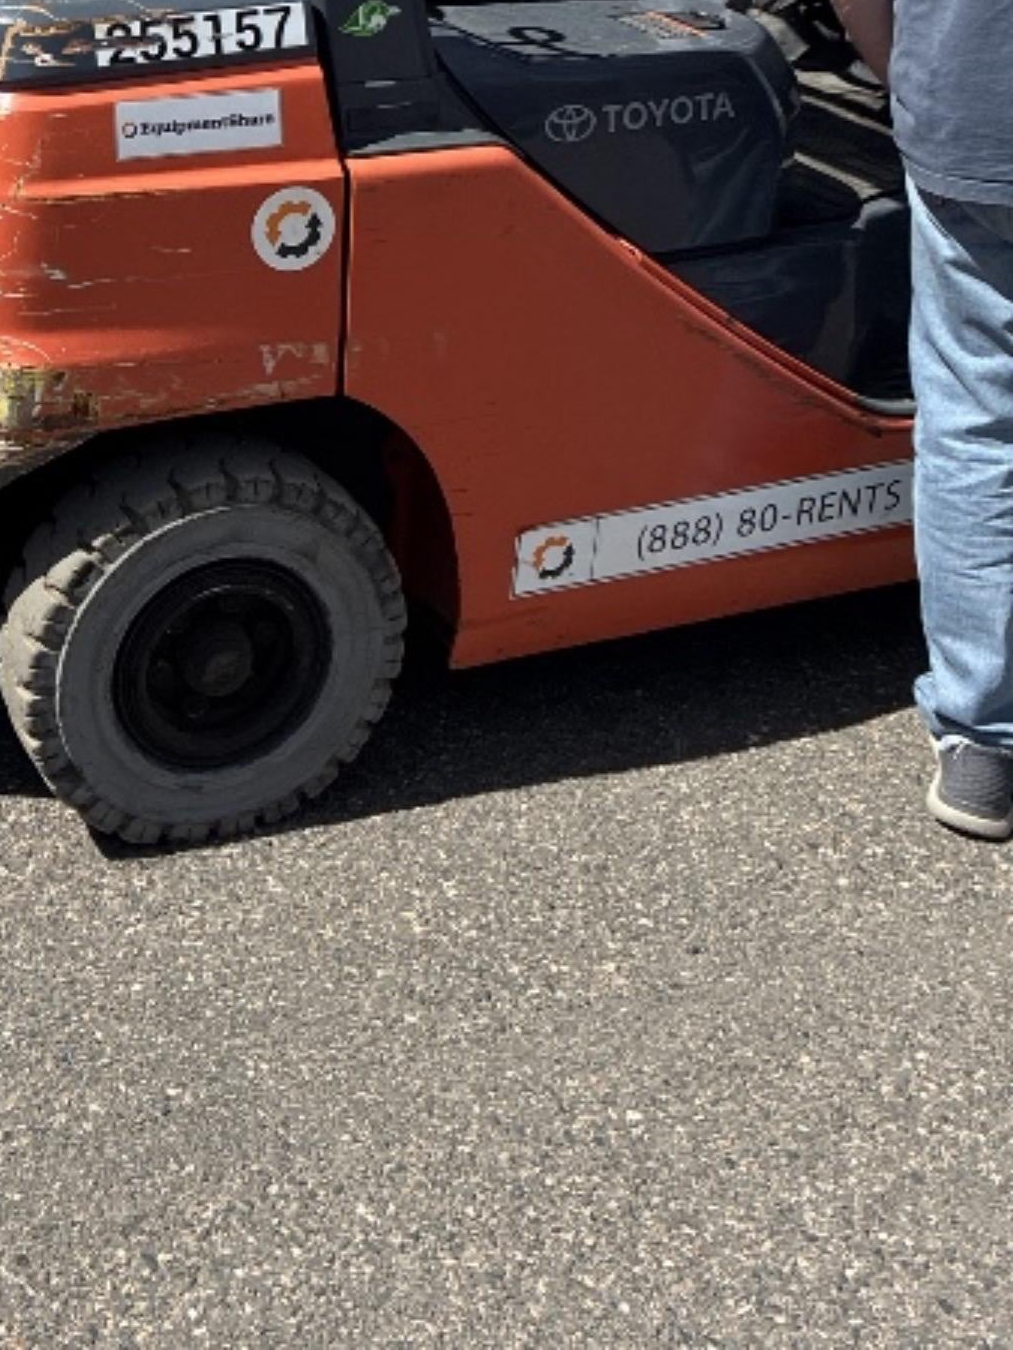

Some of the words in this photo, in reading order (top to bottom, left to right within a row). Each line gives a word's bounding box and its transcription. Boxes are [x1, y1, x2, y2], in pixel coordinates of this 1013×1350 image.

[104, 5, 291, 65] 255157
[602, 92, 736, 134] TOYOTA
[637, 511, 723, 560] (888)
[737, 479, 902, 538] 80-RENTS
